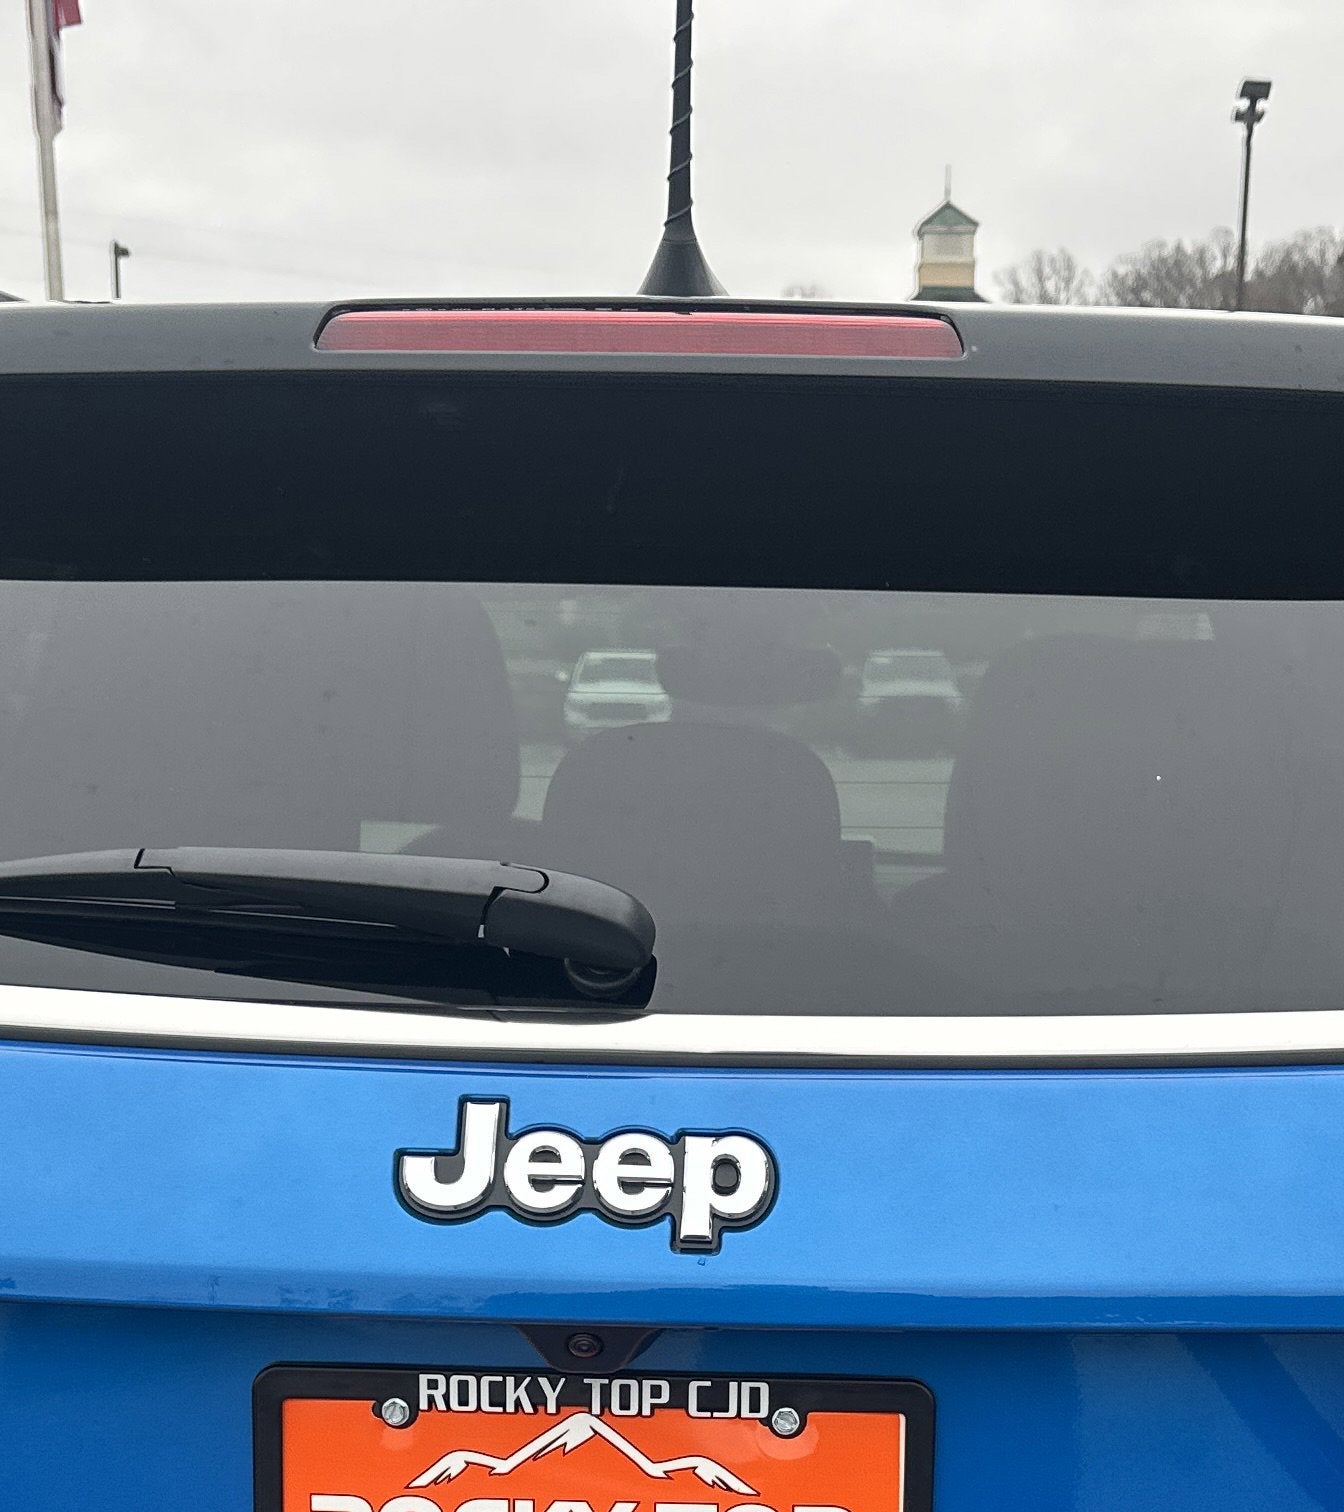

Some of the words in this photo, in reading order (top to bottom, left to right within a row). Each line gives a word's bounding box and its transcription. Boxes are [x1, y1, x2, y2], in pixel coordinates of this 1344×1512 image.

[397, 1097, 775, 1247] Jeep
[419, 1373, 565, 1415] ROCKY
[583, 1377, 671, 1418] TOP
[688, 1380, 770, 1420] CJD
